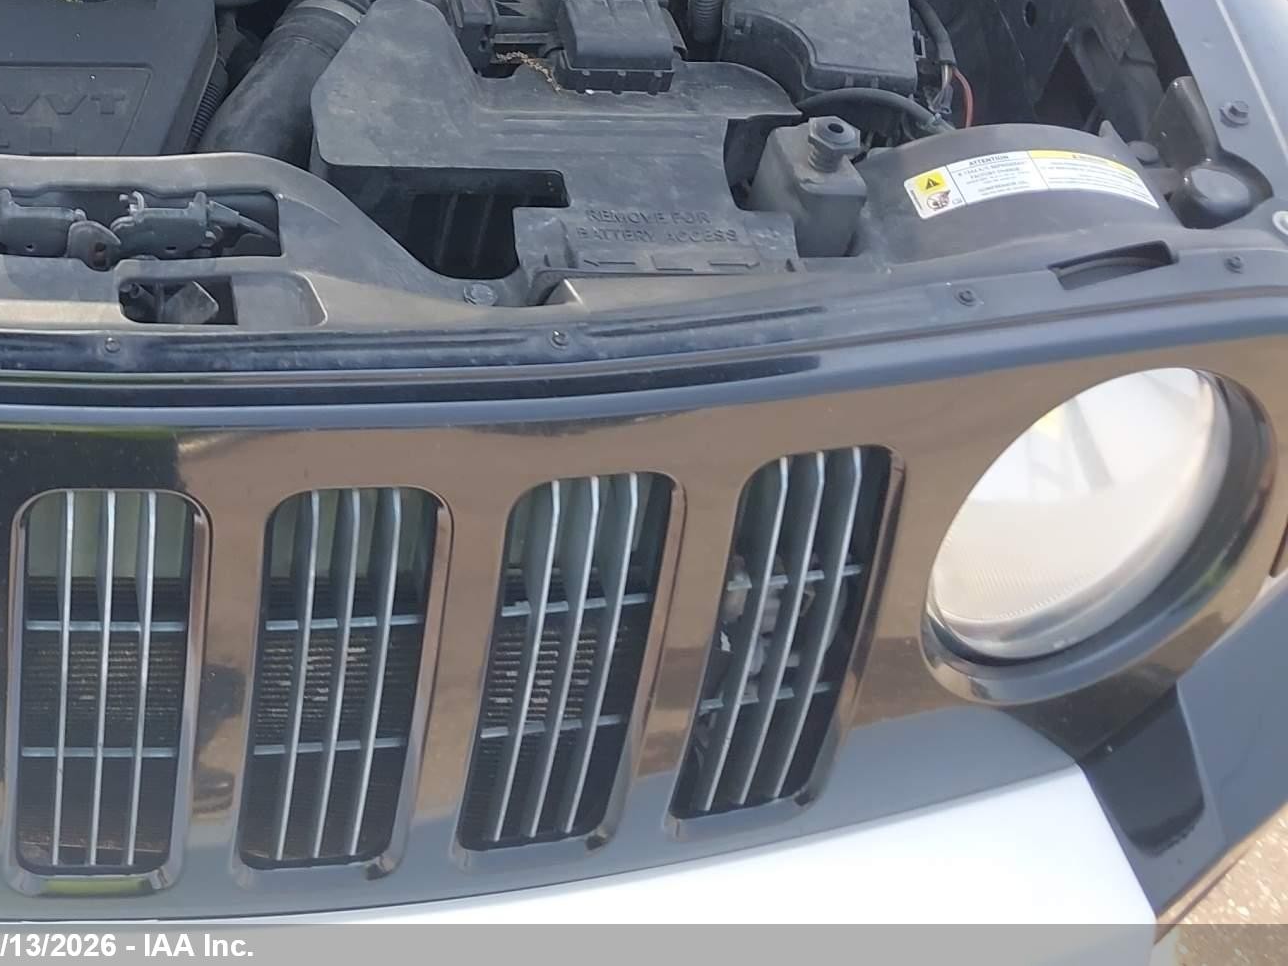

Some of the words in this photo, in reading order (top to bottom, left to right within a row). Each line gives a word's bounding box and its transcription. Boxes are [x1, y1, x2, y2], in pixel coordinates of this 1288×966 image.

[585, 209, 665, 225] REMOVE
[671, 210, 711, 225] FOR
[576, 227, 655, 243] BATTERY
[667, 229, 739, 243] ACCESS
